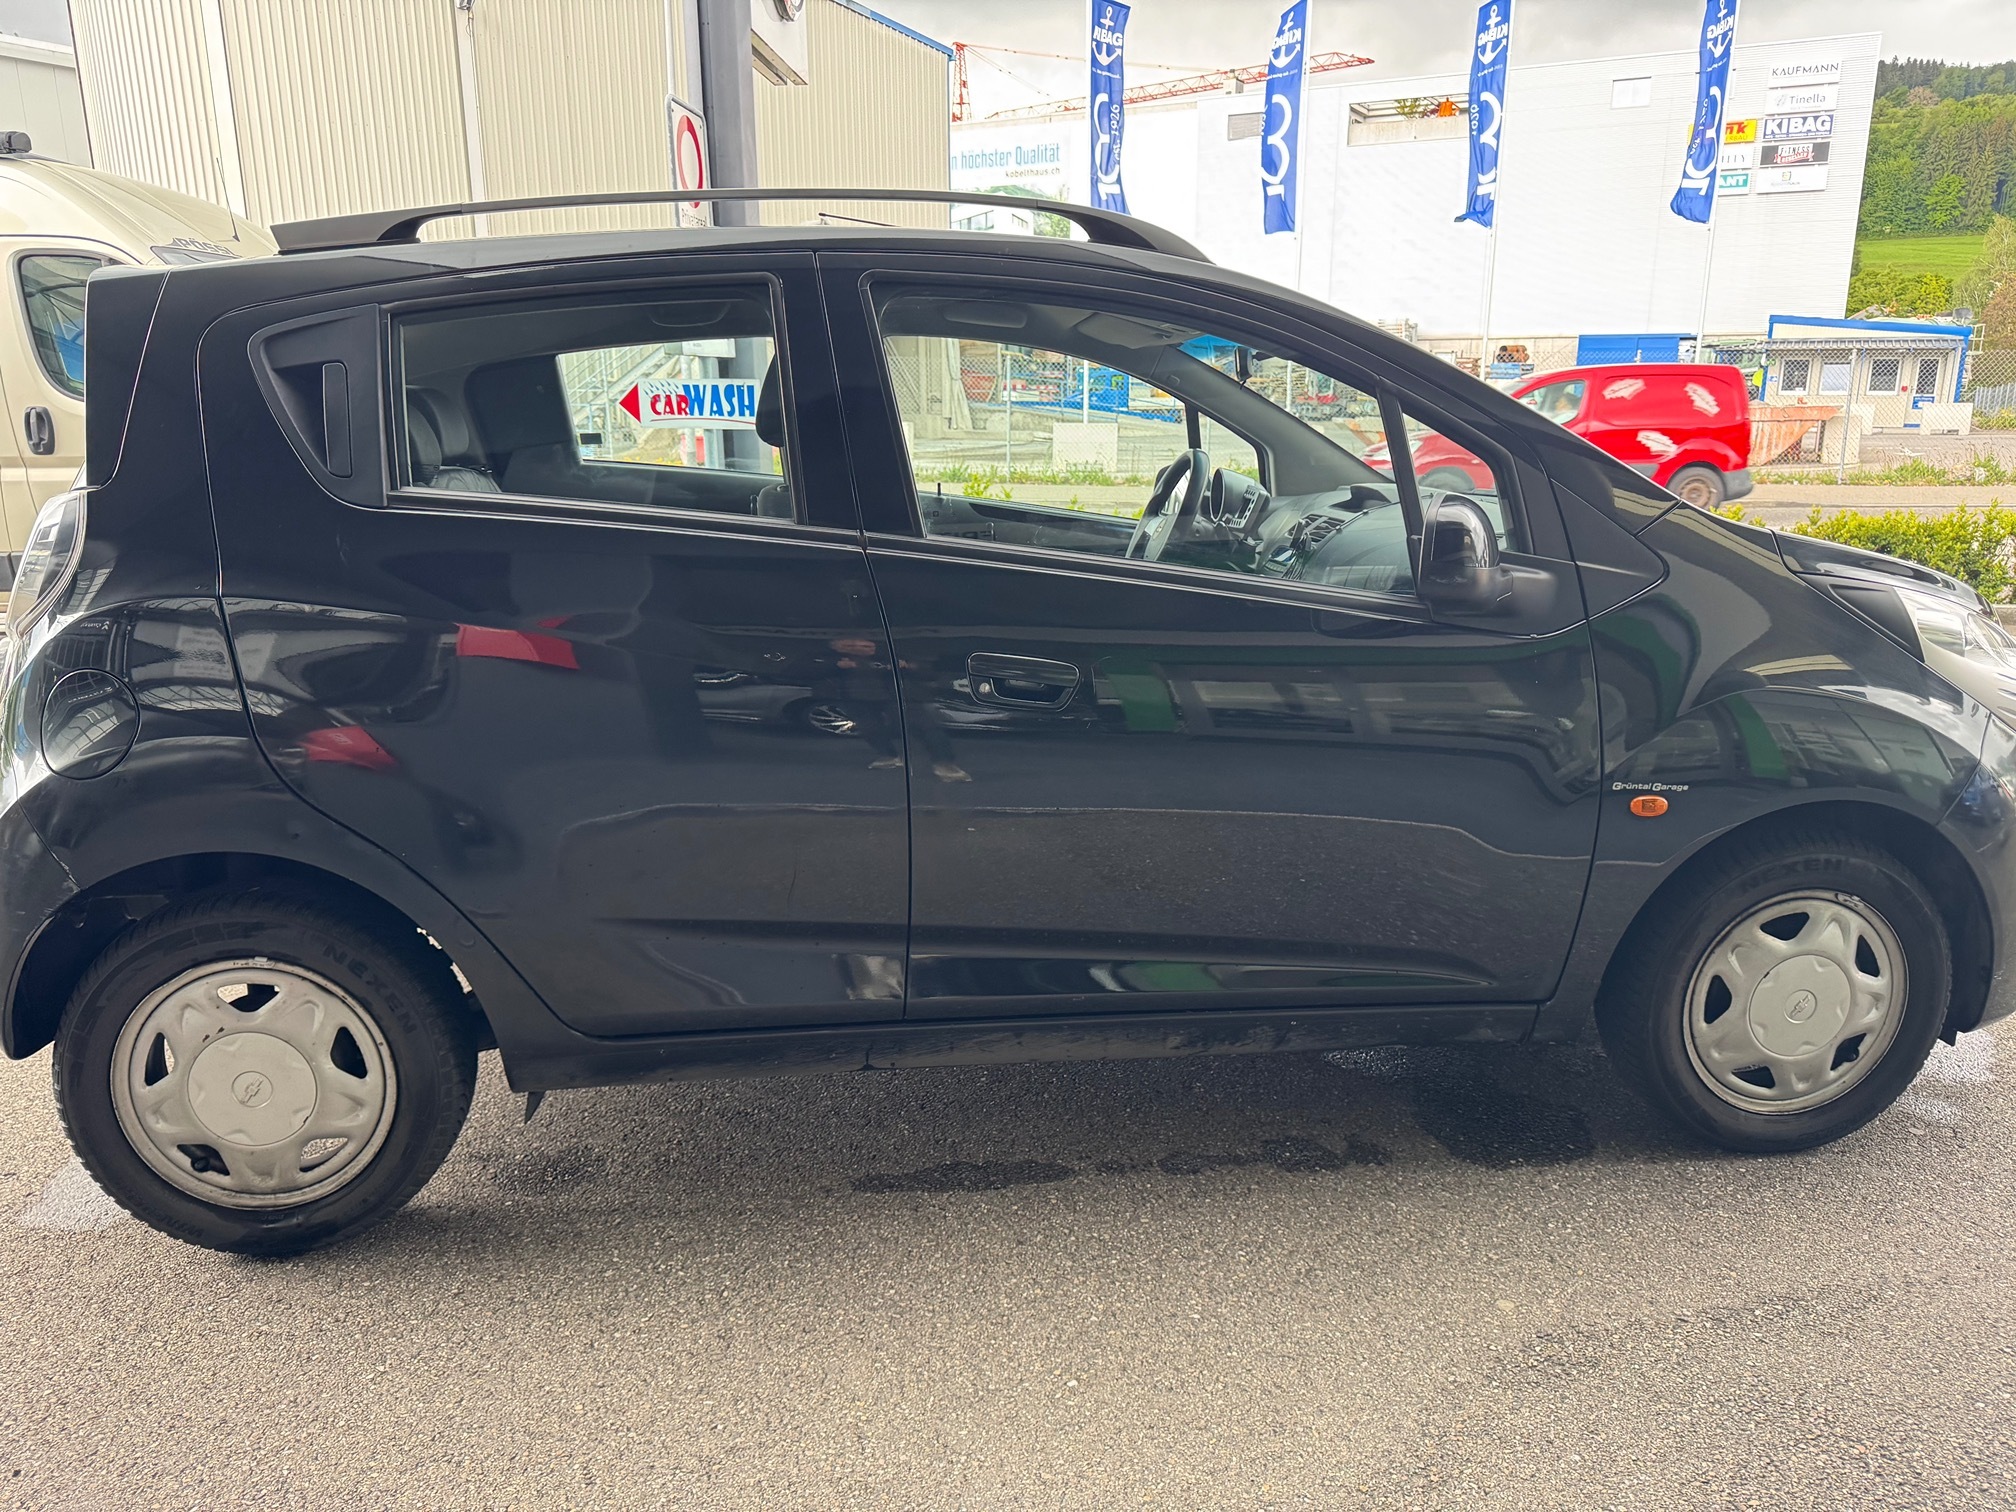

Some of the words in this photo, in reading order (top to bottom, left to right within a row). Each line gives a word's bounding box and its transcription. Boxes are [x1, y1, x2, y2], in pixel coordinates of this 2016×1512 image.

[1771, 62, 1839, 76] KAUFMANN
[1789, 93, 1826, 105] Tinella
[1765, 115, 1832, 135] KIBAG
[961, 148, 1012, 169] höchster
[1015, 142, 1060, 166] Qualität
[1005, 167, 1061, 178] kobelthaus.ch
[1612, 781, 1652, 791] Grüntal
[1652, 782, 1689, 792] Garage
[322, 943, 419, 1035] NEXEN
